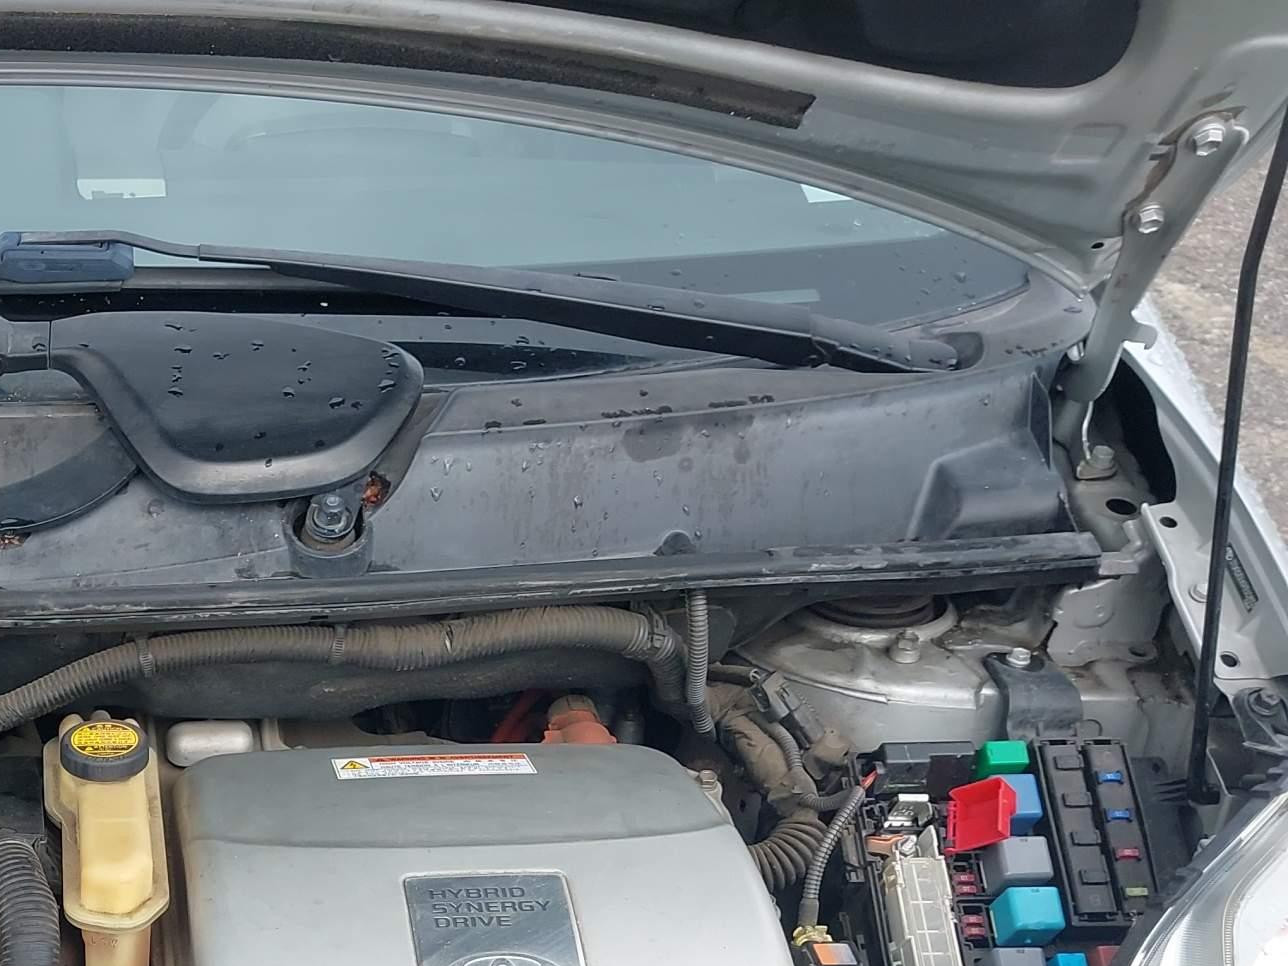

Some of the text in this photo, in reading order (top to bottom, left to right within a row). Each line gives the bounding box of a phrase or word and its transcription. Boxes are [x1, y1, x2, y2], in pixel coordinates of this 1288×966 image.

[430, 887, 525, 900] HYBRID
[432, 900, 550, 915] SYNERGY
[435, 915, 513, 928] DRIVE
